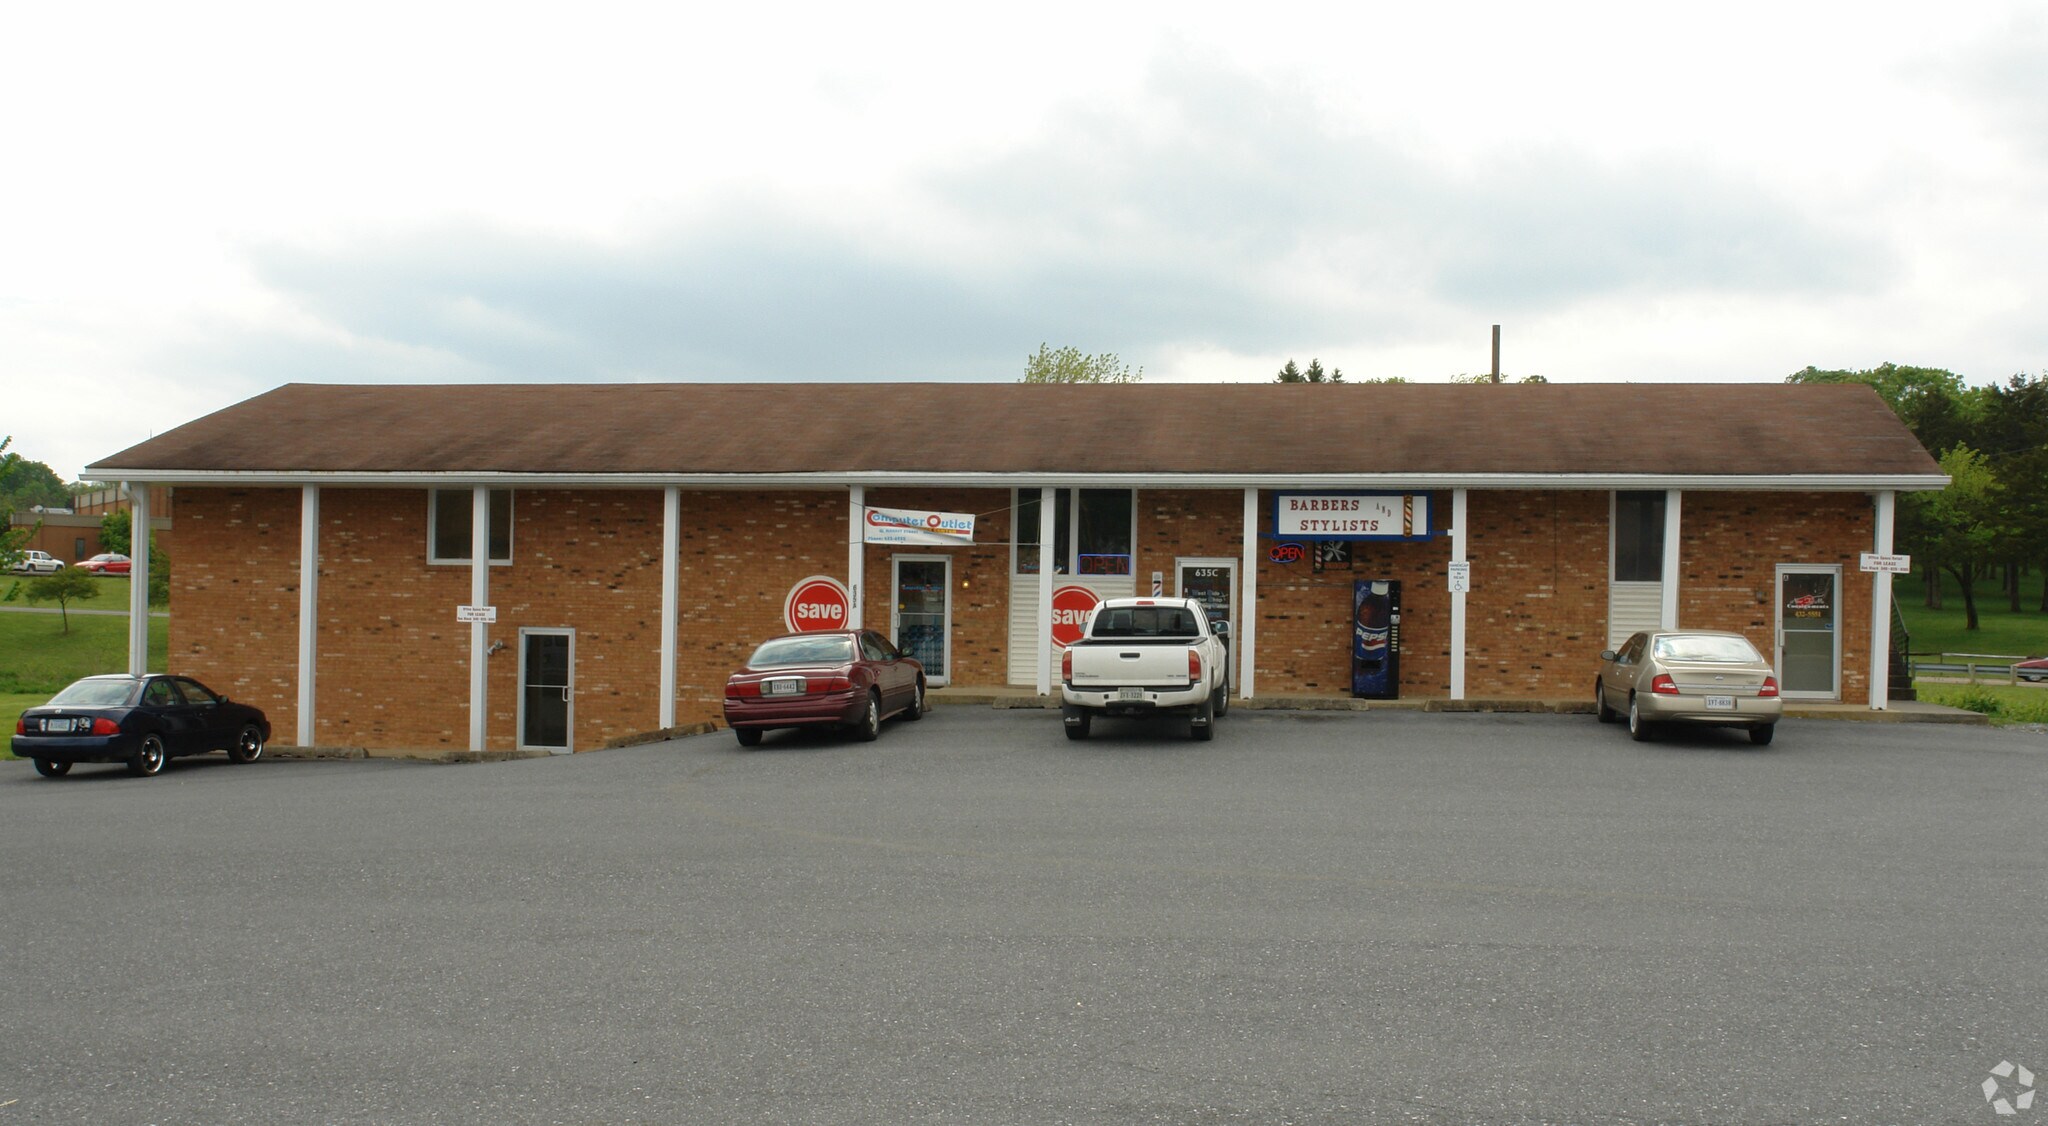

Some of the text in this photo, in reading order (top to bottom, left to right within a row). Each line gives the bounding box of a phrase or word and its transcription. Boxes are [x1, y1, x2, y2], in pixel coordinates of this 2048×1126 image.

[1290, 499, 1360, 511] BARBERS
[1375, 502, 1392, 518] AND
[866, 509, 972, 530] Computer Outlet
[1300, 520, 1379, 532] STYLISTS
[1270, 547, 1305, 560] OPEN
[1080, 556, 1129, 574] OPEN
[1195, 568, 1219, 577] 635C
[797, 602, 842, 620] save
[1356, 627, 1388, 642] PEPSI
